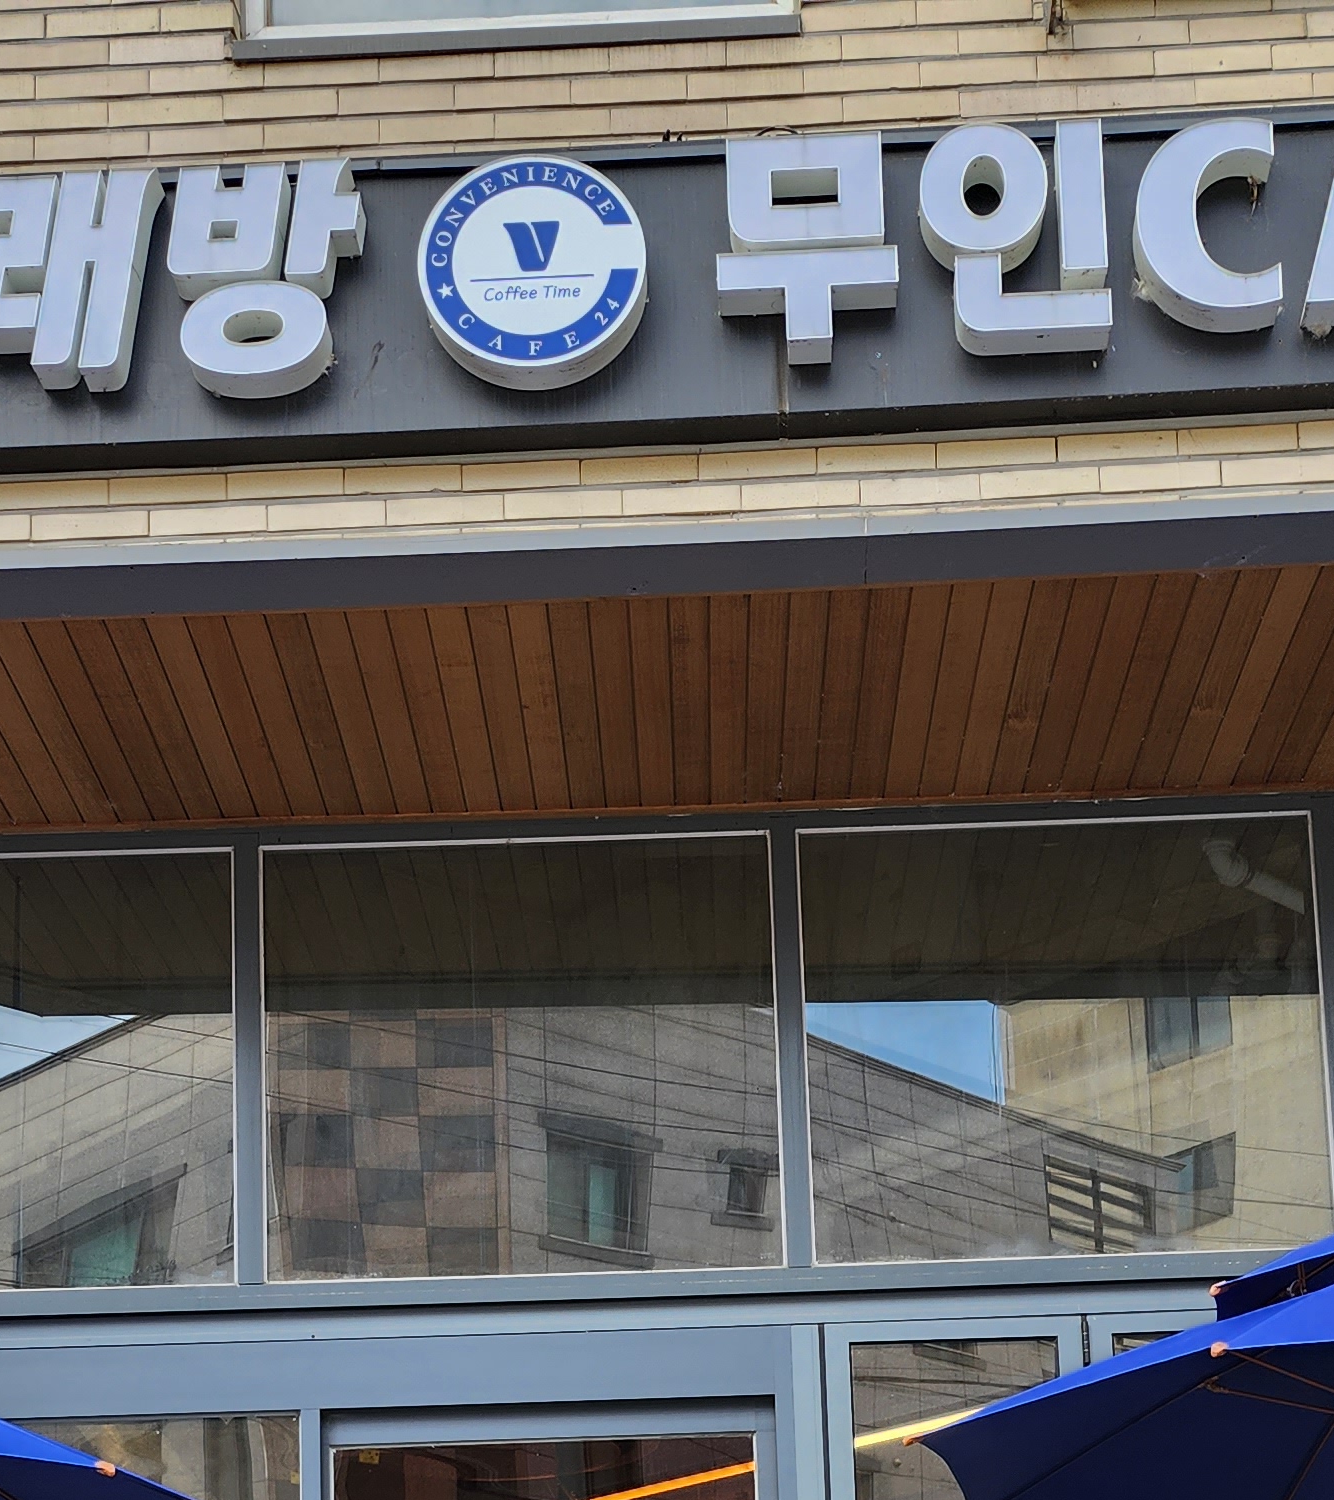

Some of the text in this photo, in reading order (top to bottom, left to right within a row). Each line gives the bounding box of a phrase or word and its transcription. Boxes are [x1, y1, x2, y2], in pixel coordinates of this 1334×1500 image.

[431, 166, 616, 267] CONVENIENCE
[484, 284, 581, 302] Coffee Time
[458, 297, 620, 356] CAFE 24
